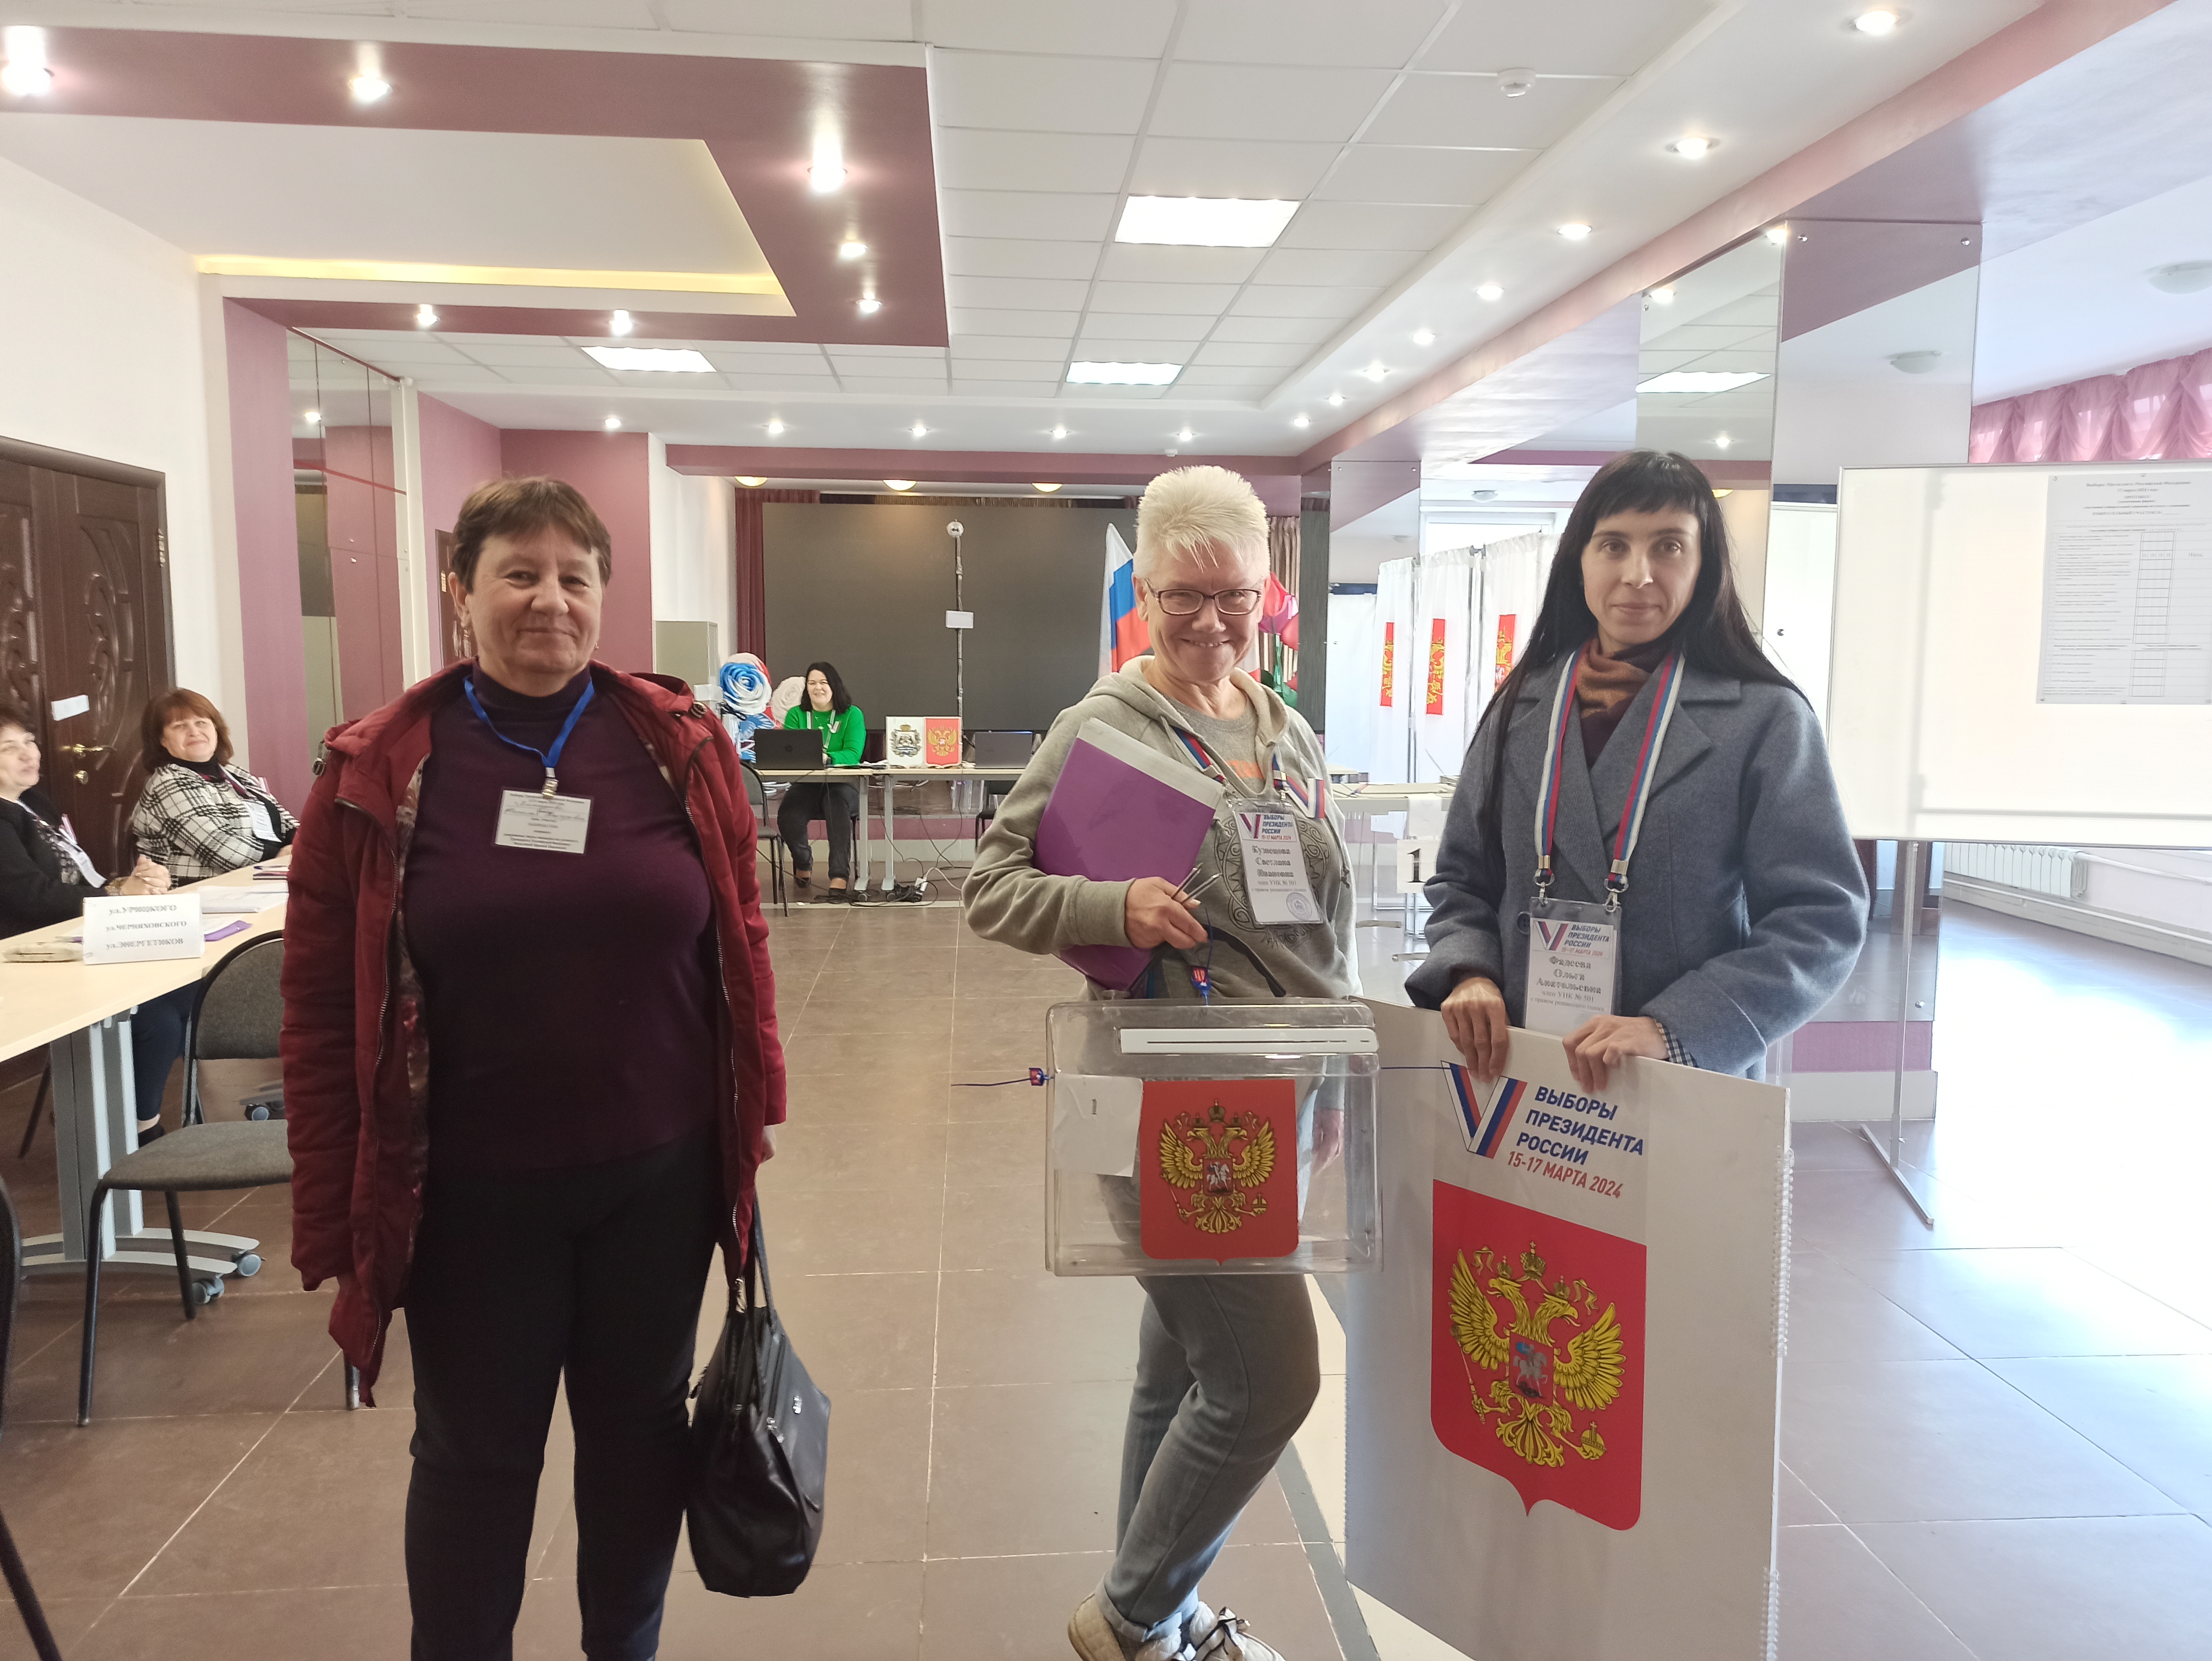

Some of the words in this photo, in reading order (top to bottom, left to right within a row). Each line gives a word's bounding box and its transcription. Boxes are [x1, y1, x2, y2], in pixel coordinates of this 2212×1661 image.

[1407, 848, 1426, 883] 1
[1568, 932, 1609, 942] ПРЕЗИДЕНТА
[1571, 924, 1601, 933] ВЫБОРЫ
[1564, 939, 1592, 948] РОССИИ
[1536, 977, 1602, 994] Анатольевна
[1553, 968, 1585, 981] Ольга
[1535, 1085, 1618, 1120] ВЫБОРЫ
[1525, 1108, 1644, 1156] ПРЕЗИДЕНТА
[1516, 1132, 1589, 1165] РОССИИ
[1507, 1151, 1543, 1173] 15-17
[1542, 1162, 1588, 1189] МАРТА
[1589, 1175, 1624, 1199] 2024
